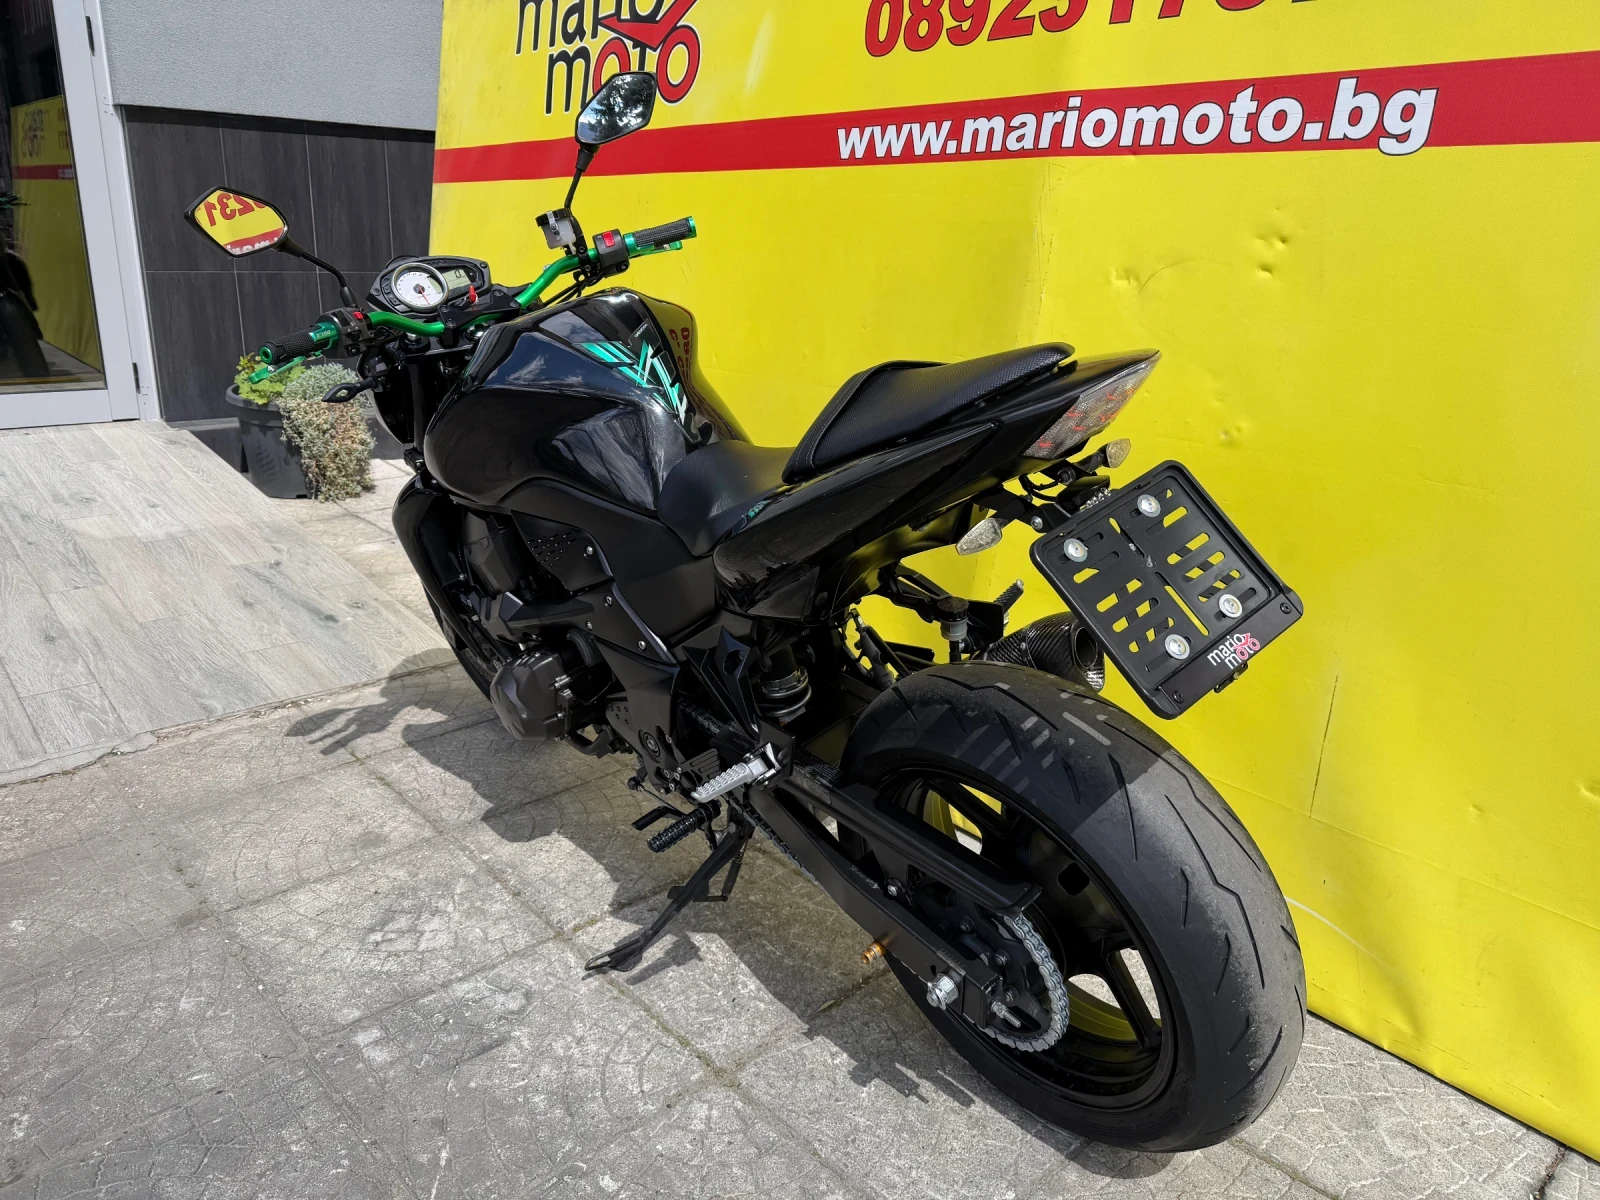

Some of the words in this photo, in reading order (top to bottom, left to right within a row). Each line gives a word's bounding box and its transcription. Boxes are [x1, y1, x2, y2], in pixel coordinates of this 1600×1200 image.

[836, 77, 1439, 155] www.mariomoto.bg
[1207, 633, 1245, 667] mario
[1224, 637, 1261, 670] moto
